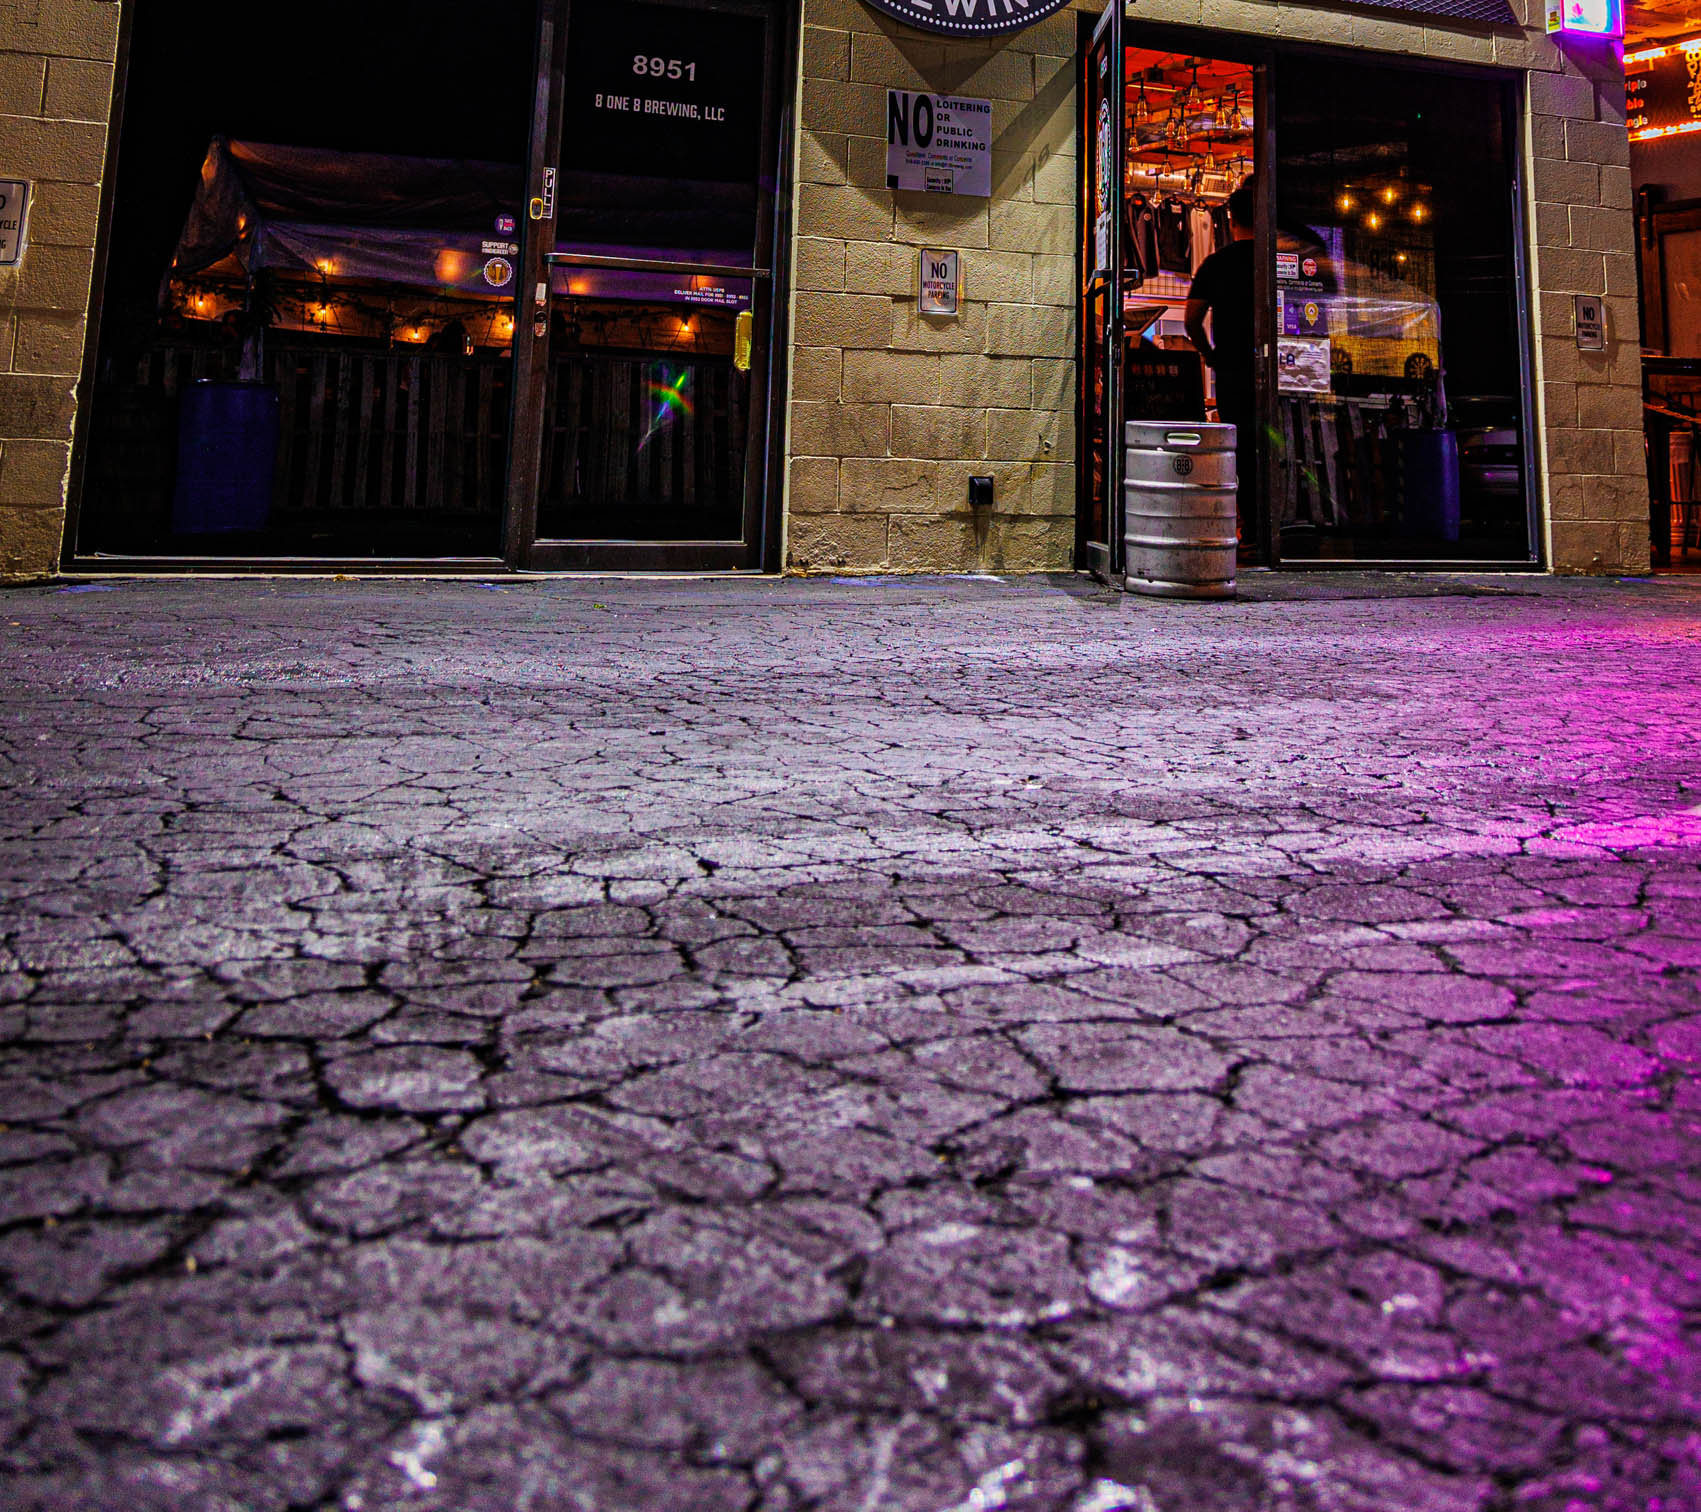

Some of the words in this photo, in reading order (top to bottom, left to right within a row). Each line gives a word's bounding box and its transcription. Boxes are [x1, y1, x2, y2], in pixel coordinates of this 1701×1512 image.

[632, 55, 696, 81] 8951
[595, 94, 603, 108] 8
[607, 95, 630, 111] ONE
[633, 98, 641, 112] 8
[644, 99, 701, 120] BREWING,
[705, 106, 725, 121] LLC
[936, 99, 991, 114] LOITERING
[888, 91, 934, 148] NO
[936, 113, 951, 122] OR
[936, 126, 973, 137] PUBLIC
[936, 139, 986, 151] DRINKING
[544, 170, 553, 206] PULL
[931, 263, 947, 279] NO
[1583, 306, 1595, 320] NO
